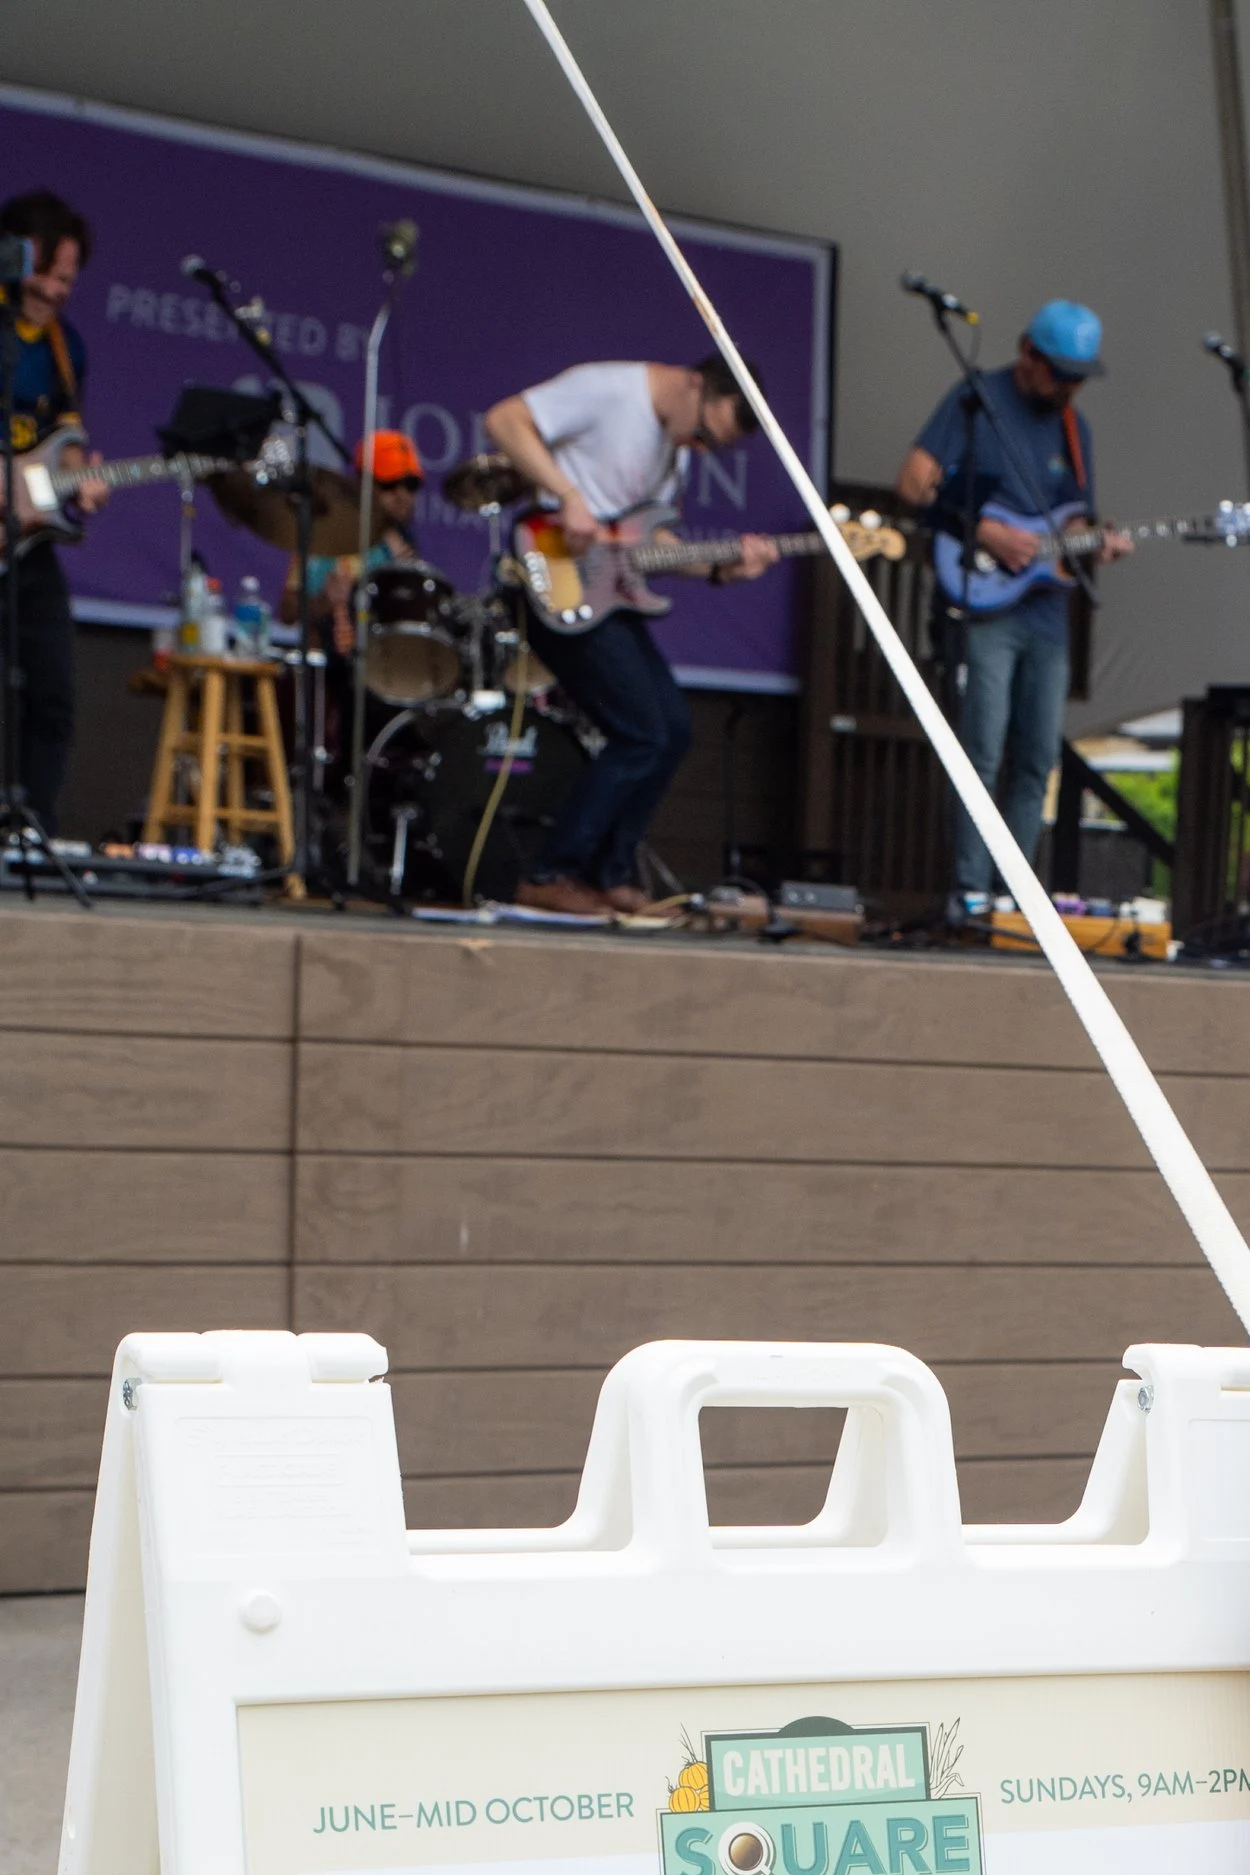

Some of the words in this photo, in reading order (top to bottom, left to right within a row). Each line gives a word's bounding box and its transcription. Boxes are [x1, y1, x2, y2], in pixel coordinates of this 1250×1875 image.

[106, 283, 327, 356] PRESEED
[723, 1743, 915, 1797] CATHEDRAL
[999, 1773, 1133, 1805] SUNDAYS,
[485, 1791, 635, 1825] OCTOBER
